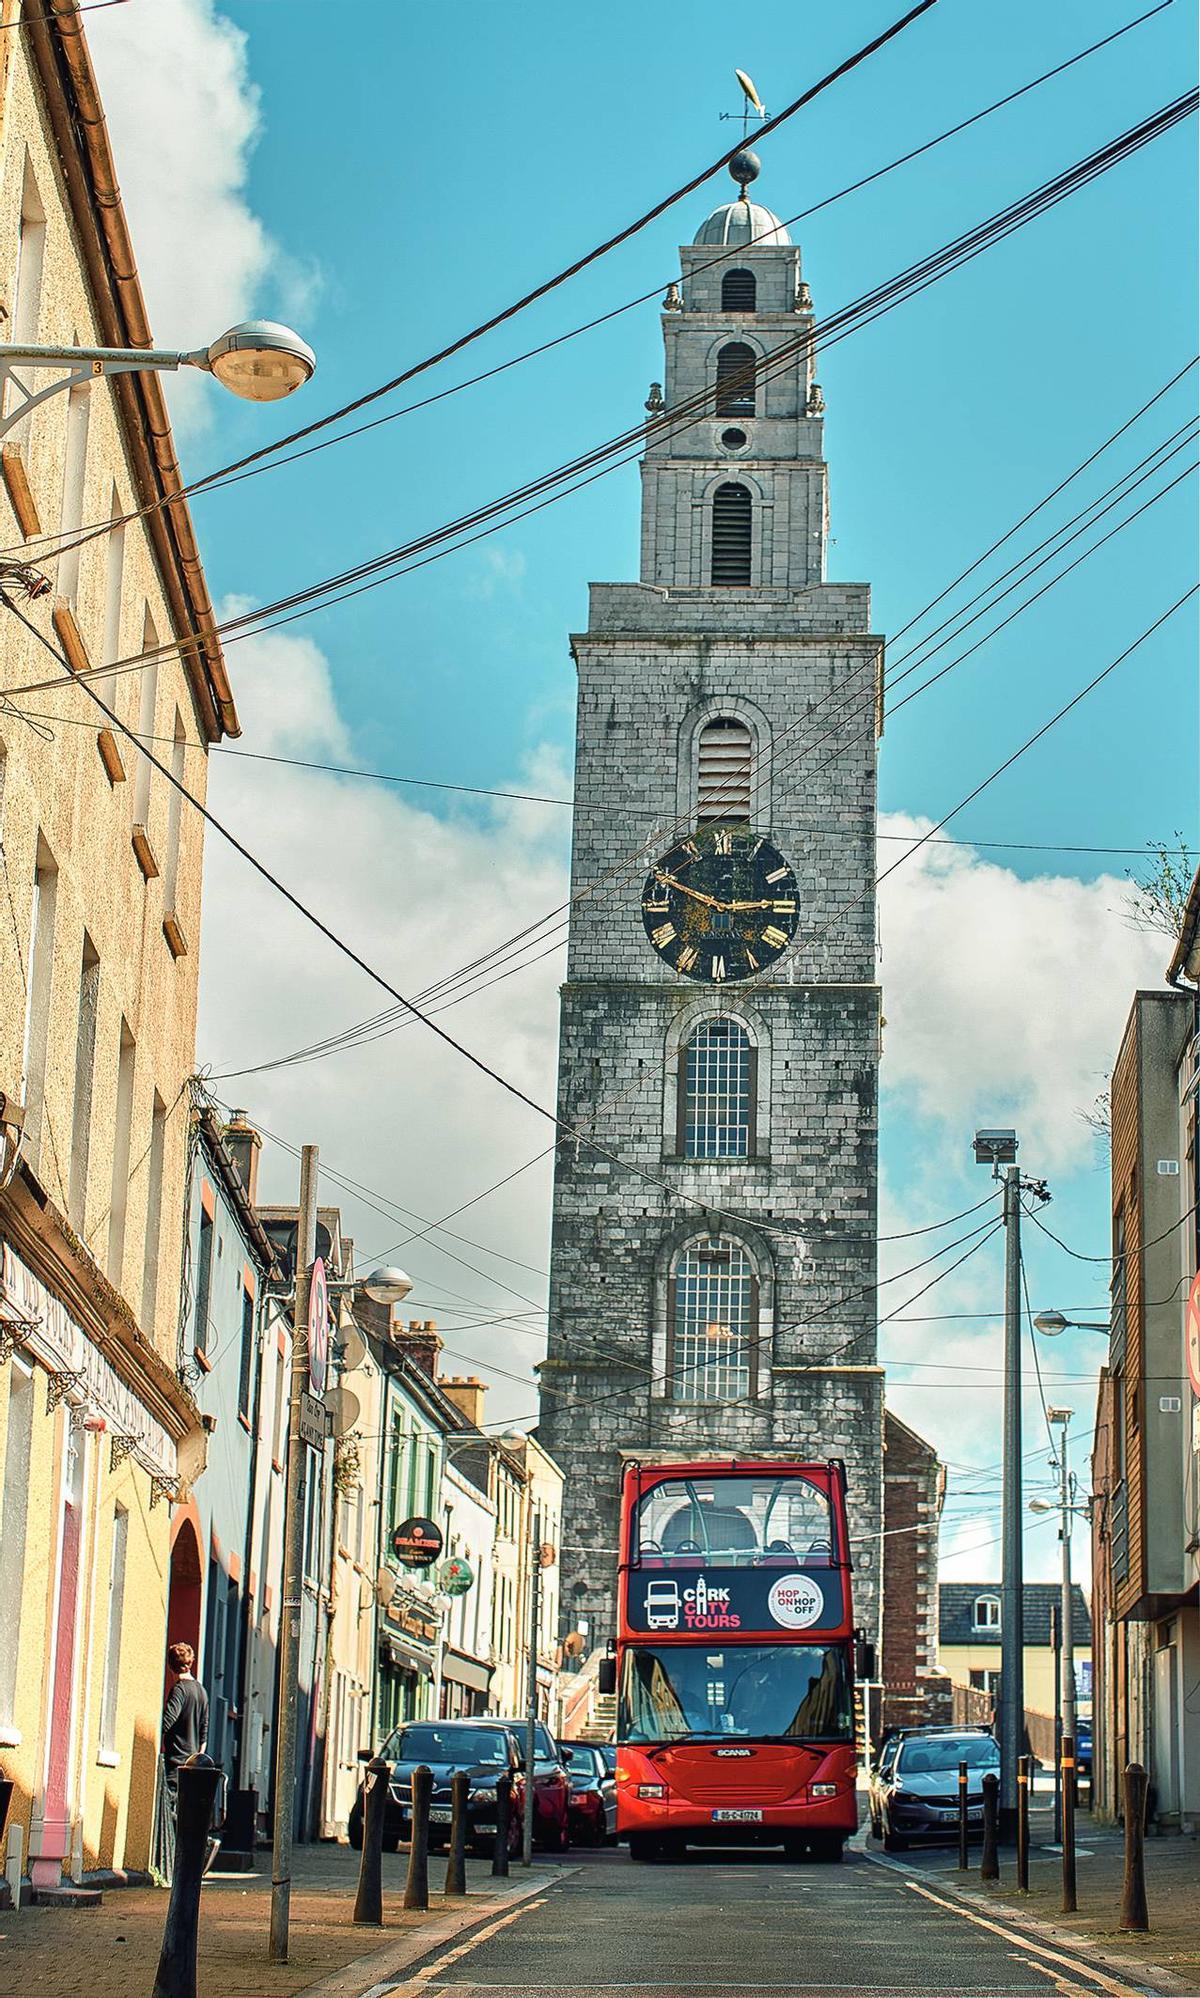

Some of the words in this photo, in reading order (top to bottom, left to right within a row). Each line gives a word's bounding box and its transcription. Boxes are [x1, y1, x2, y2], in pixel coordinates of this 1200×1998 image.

[94, 361, 103, 374] 3
[683, 1588, 731, 1602] CORK
[777, 1590, 800, 1598] HOP
[684, 1602, 730, 1615] CITY
[778, 1598, 793, 1606] ON
[794, 1598, 816, 1606] HOP
[794, 1606, 814, 1615] OFF
[684, 1615, 741, 1628] TOURS
